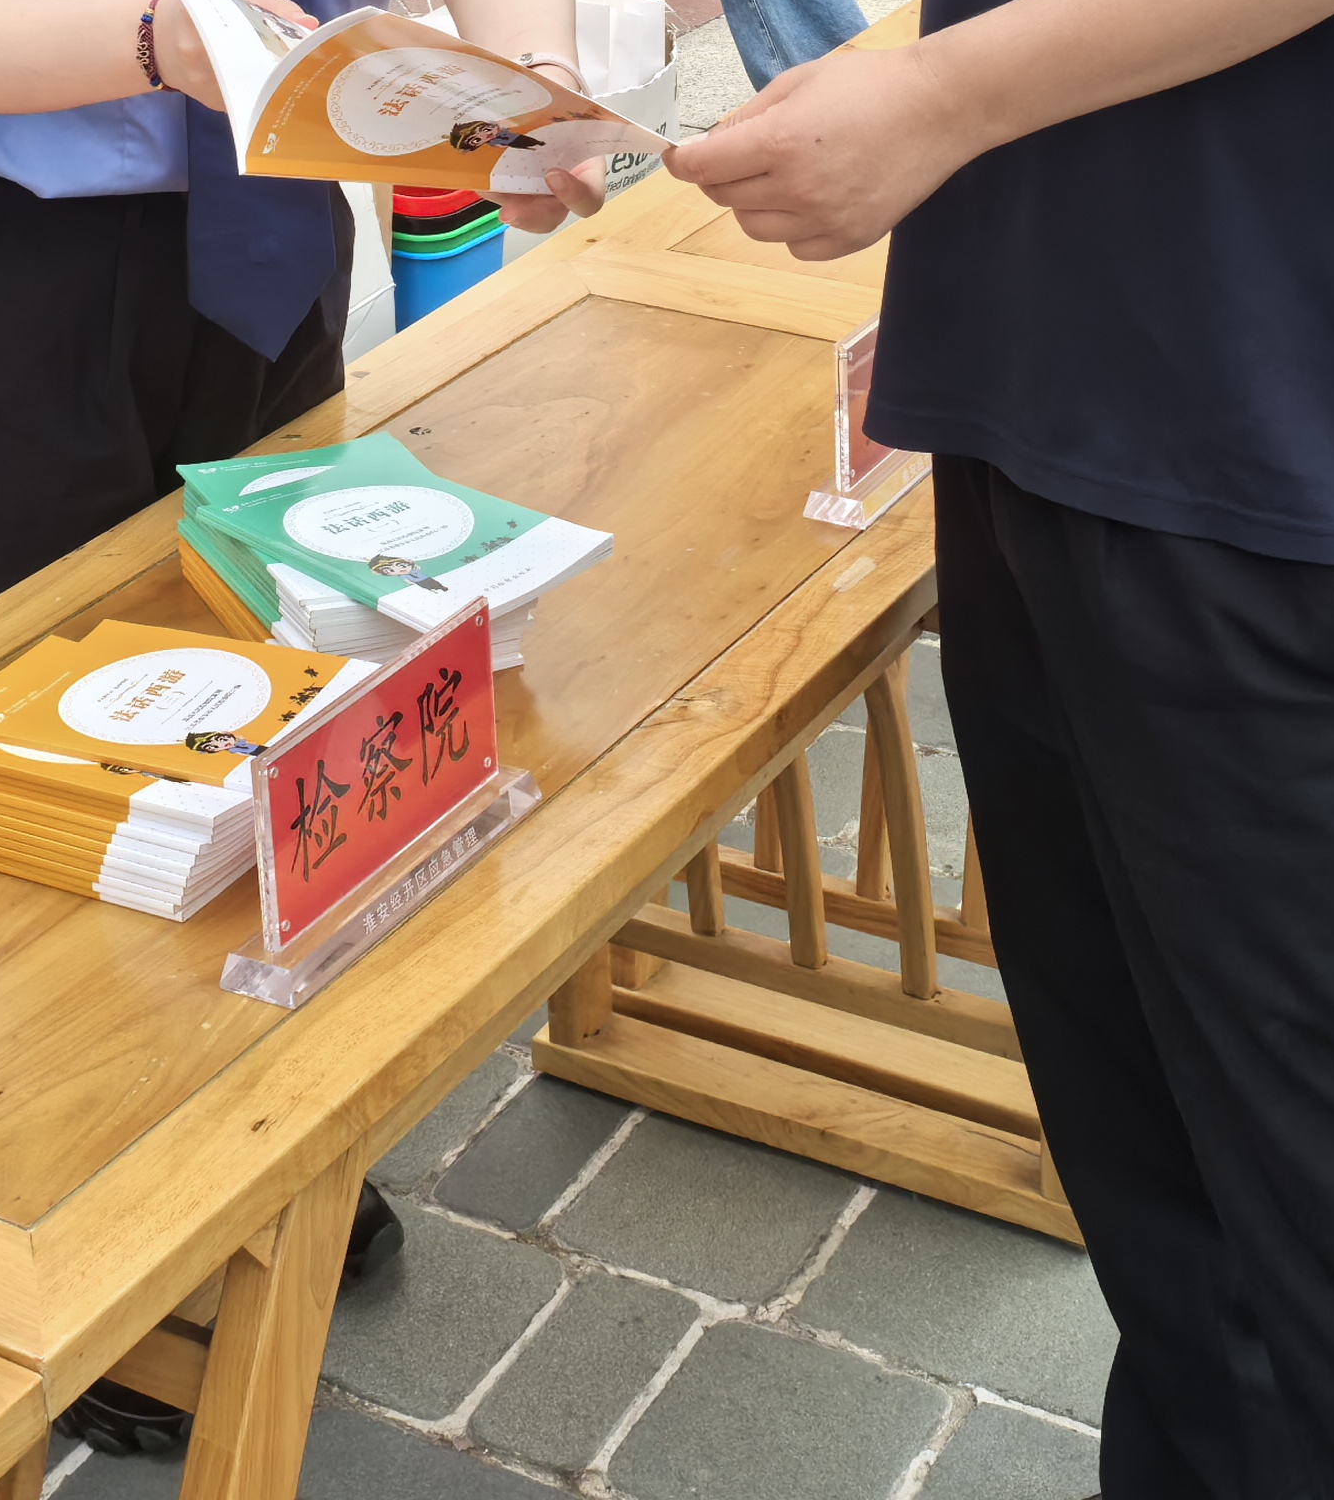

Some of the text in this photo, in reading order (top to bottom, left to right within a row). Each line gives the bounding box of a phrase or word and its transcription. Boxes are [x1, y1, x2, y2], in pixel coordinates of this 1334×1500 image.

[321, 499, 411, 535] 法话西游
[108, 668, 187, 723] 法话西游
[291, 668, 470, 882] 检察院
[362, 826, 479, 935] 淮安经开区应急管理
